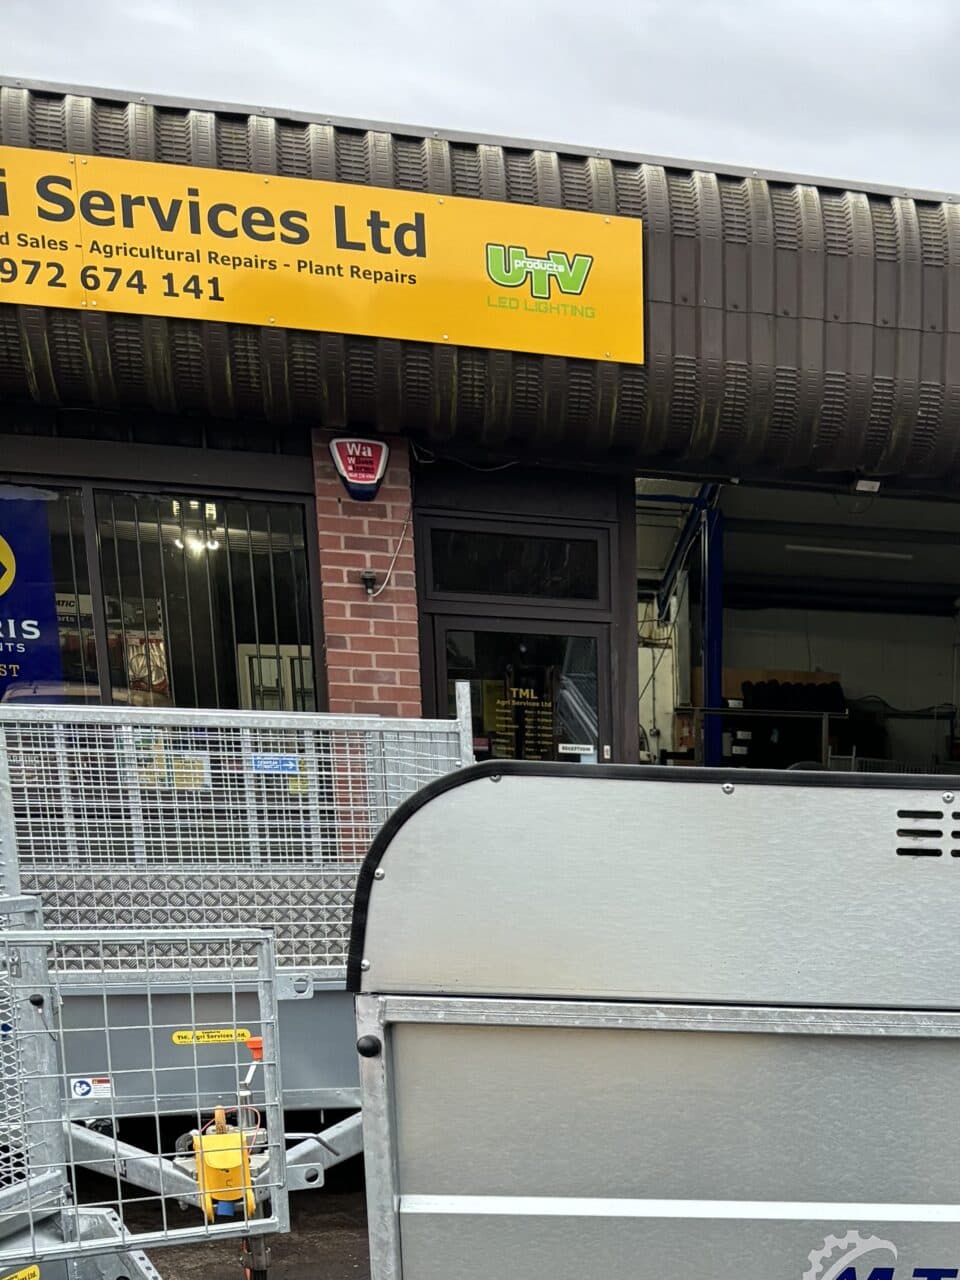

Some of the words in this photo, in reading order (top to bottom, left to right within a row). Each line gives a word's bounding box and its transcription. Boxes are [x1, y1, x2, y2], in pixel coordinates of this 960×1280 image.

[35, 175, 310, 245] Services
[334, 205, 427, 258] Ltd
[0, 257, 67, 288] 972
[80, 265, 147, 295] 674
[161, 272, 225, 302] 141
[17, 233, 68, 251] Sales
[89, 240, 201, 263] Agricultural
[207, 251, 278, 270] Repairs
[297, 259, 344, 277] Plant
[350, 265, 417, 284] Repairs
[486, 243, 594, 300] UTV
[487, 295, 519, 310] LED
[524, 299, 596, 319] LIGHTING
[346, 442, 373, 457] Wa
[510, 687, 538, 699] TML
